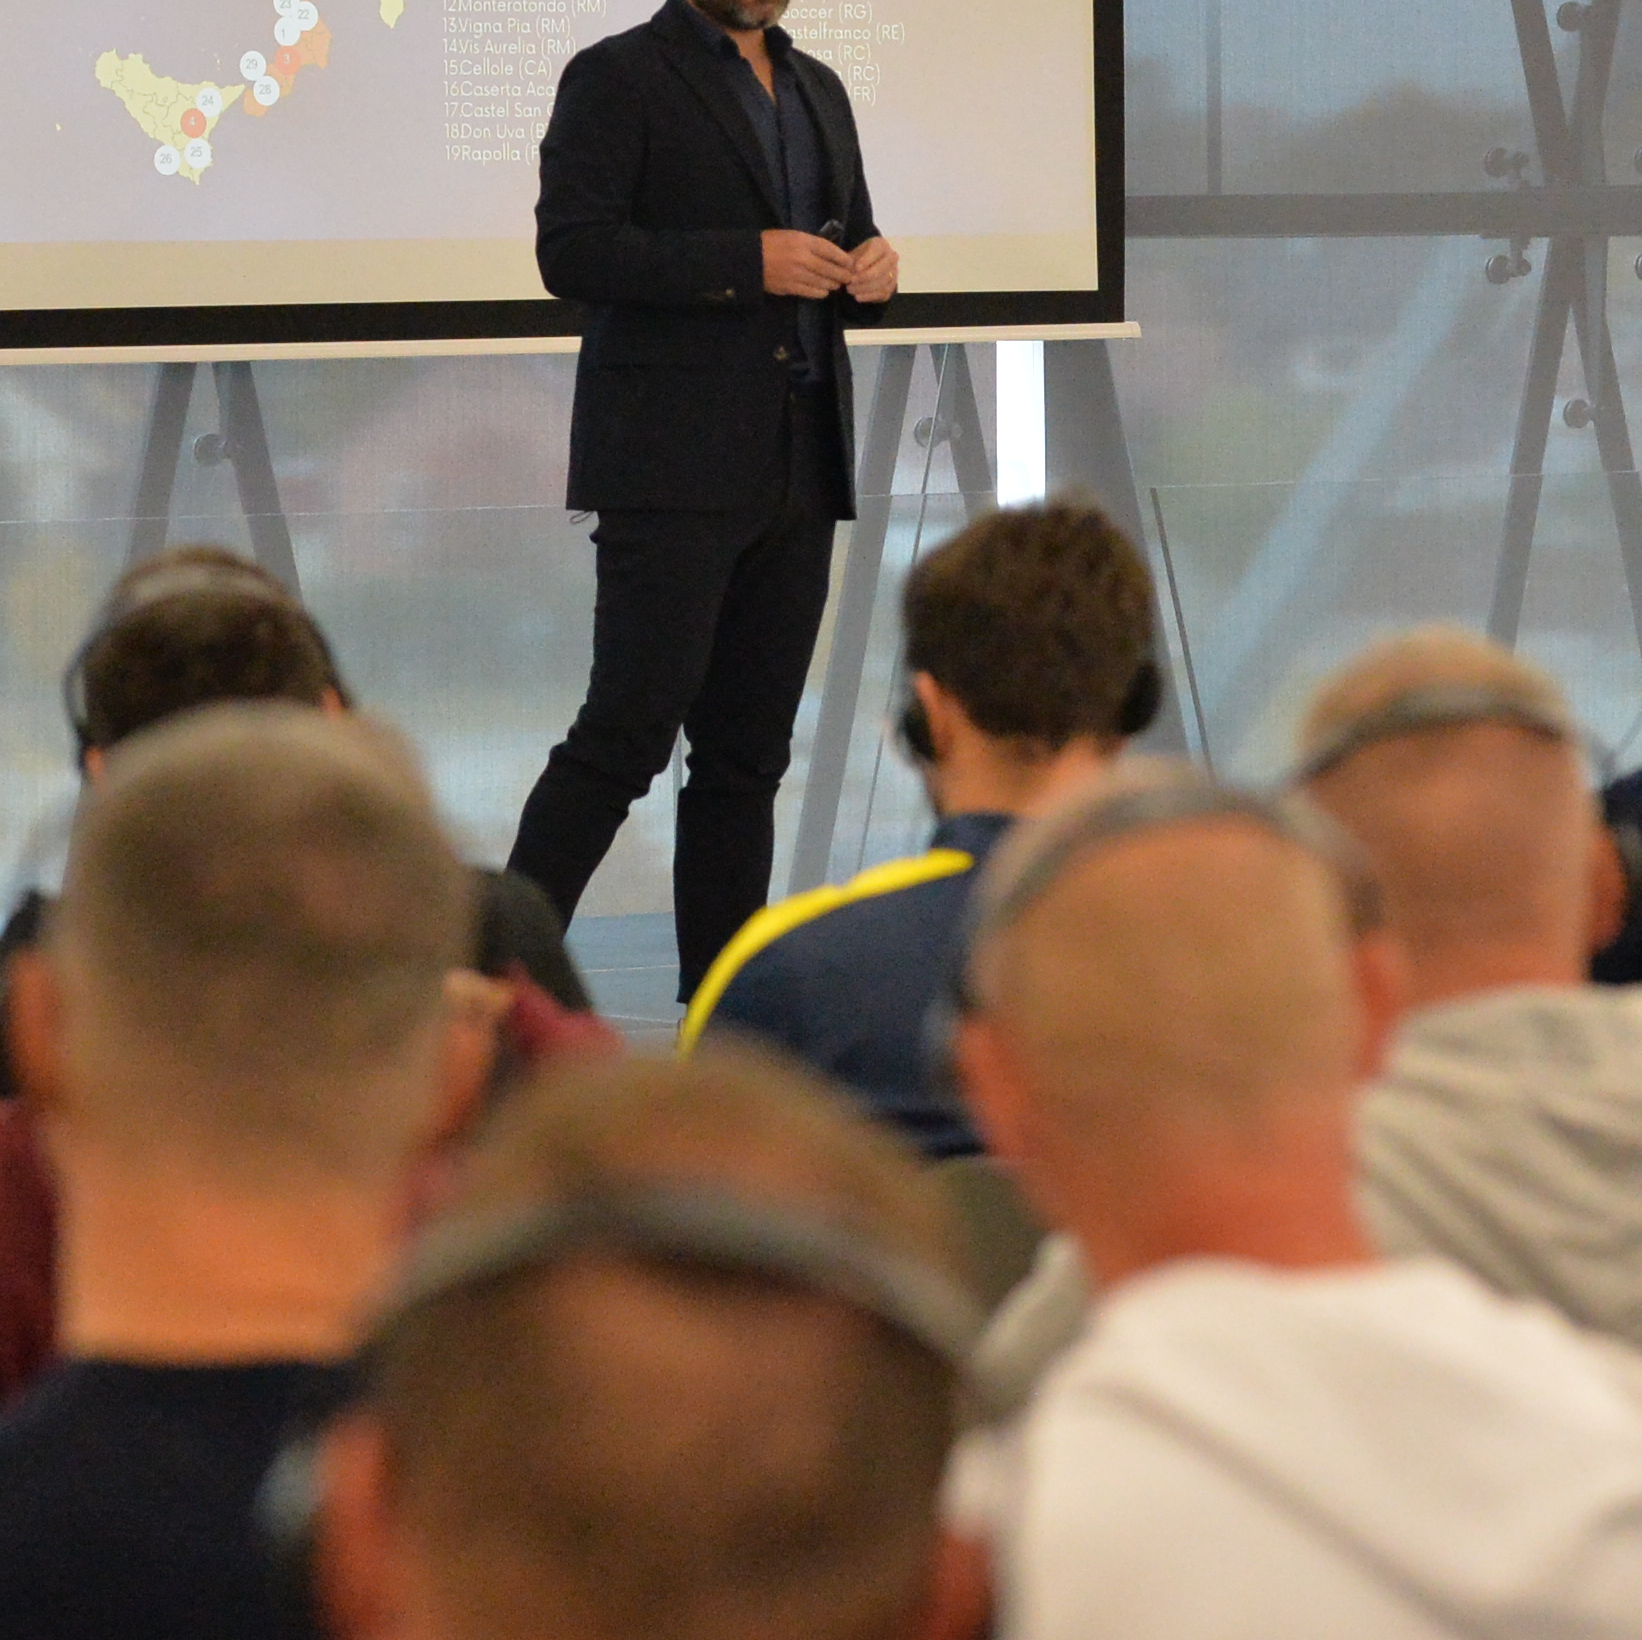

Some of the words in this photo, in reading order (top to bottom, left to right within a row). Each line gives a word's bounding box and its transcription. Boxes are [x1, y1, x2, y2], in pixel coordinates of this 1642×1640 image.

[297, 9, 310, 20] 22
[839, 1, 872, 24] (RG)
[507, 18, 531, 33] Pia
[536, 15, 571, 39] (RM)
[876, 22, 905, 45] (RE)
[485, 37, 536, 54] Aurelia
[541, 37, 576, 60] (RM)
[838, 42, 871, 65] (RC)
[246, 59, 258, 70] 29
[519, 57, 553, 81] (CA)
[848, 64, 881, 86] (RC)
[259, 83, 272, 95] 28
[201, 95, 213, 106] 24
[514, 102, 542, 118] San
[496, 124, 525, 139] Uva
[159, 153, 172, 164] 26
[190, 147, 202, 157] 25
